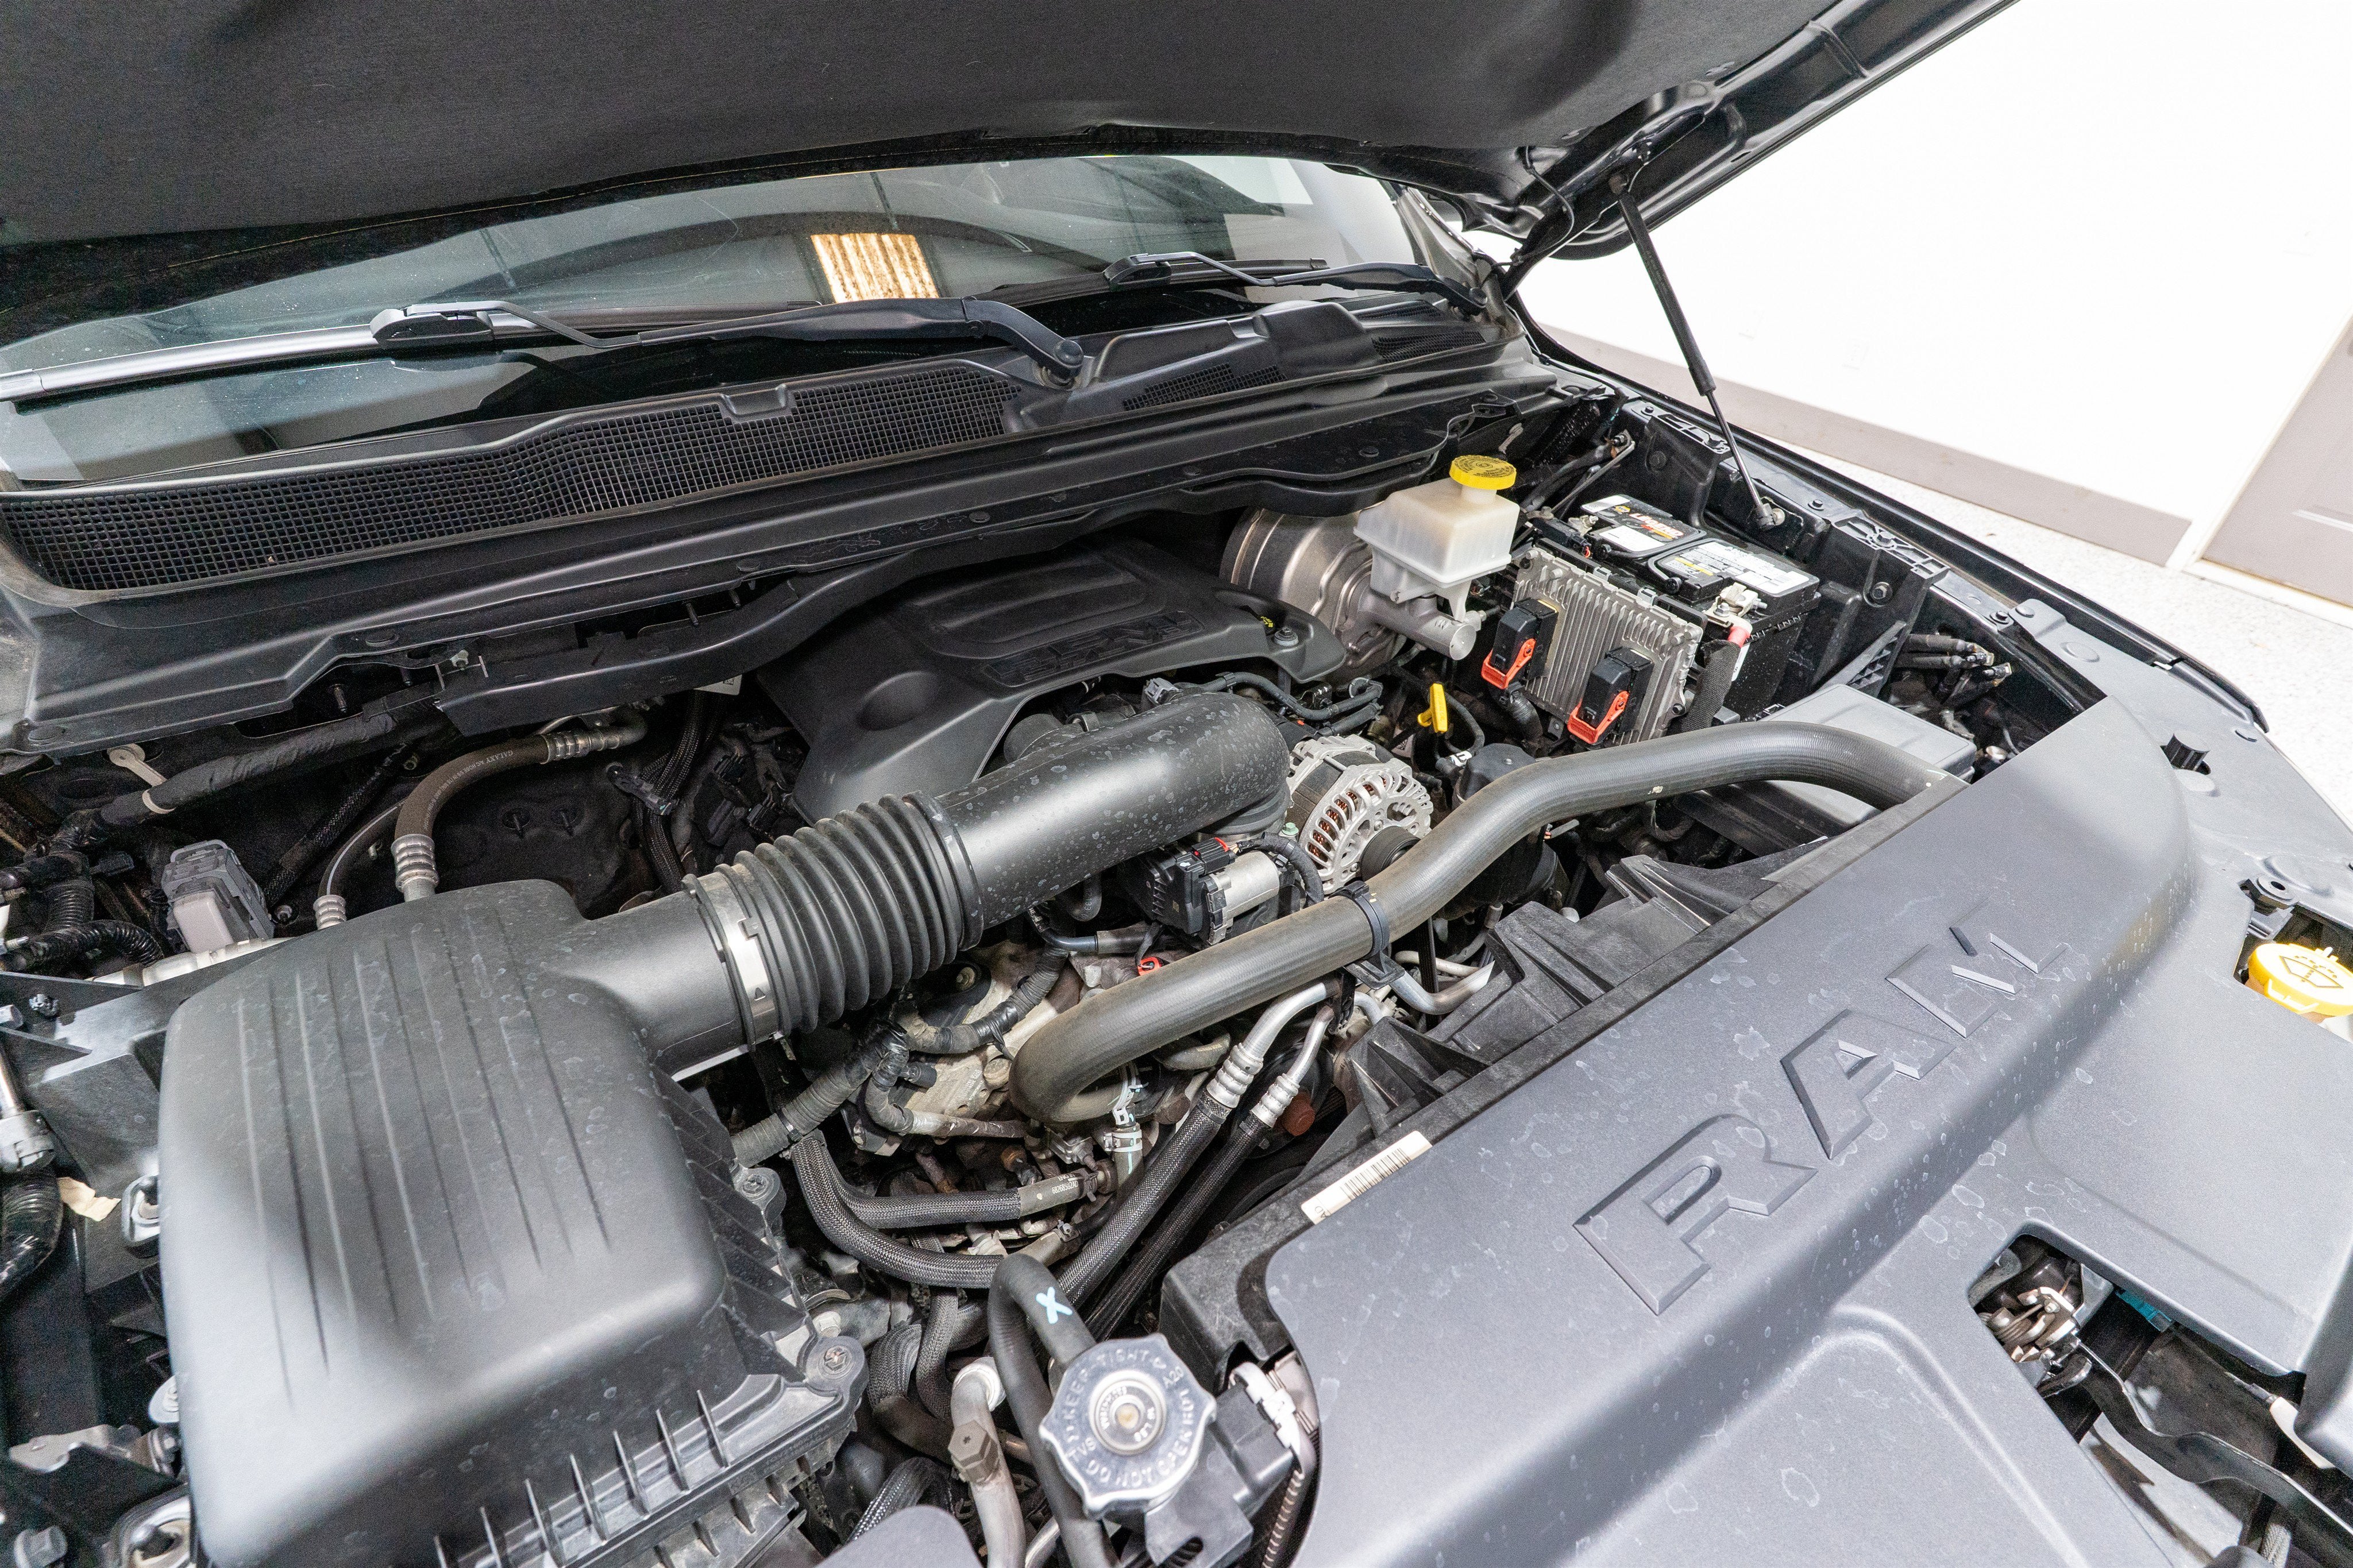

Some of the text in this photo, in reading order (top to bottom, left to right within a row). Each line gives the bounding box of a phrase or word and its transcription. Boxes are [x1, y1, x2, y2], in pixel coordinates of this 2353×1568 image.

[1629, 513, 1684, 536] LEGEND
[486, 750, 513, 764] GALAXY
[464, 764, 476, 774] HOSE
[1573, 899, 2069, 1316] RAM
